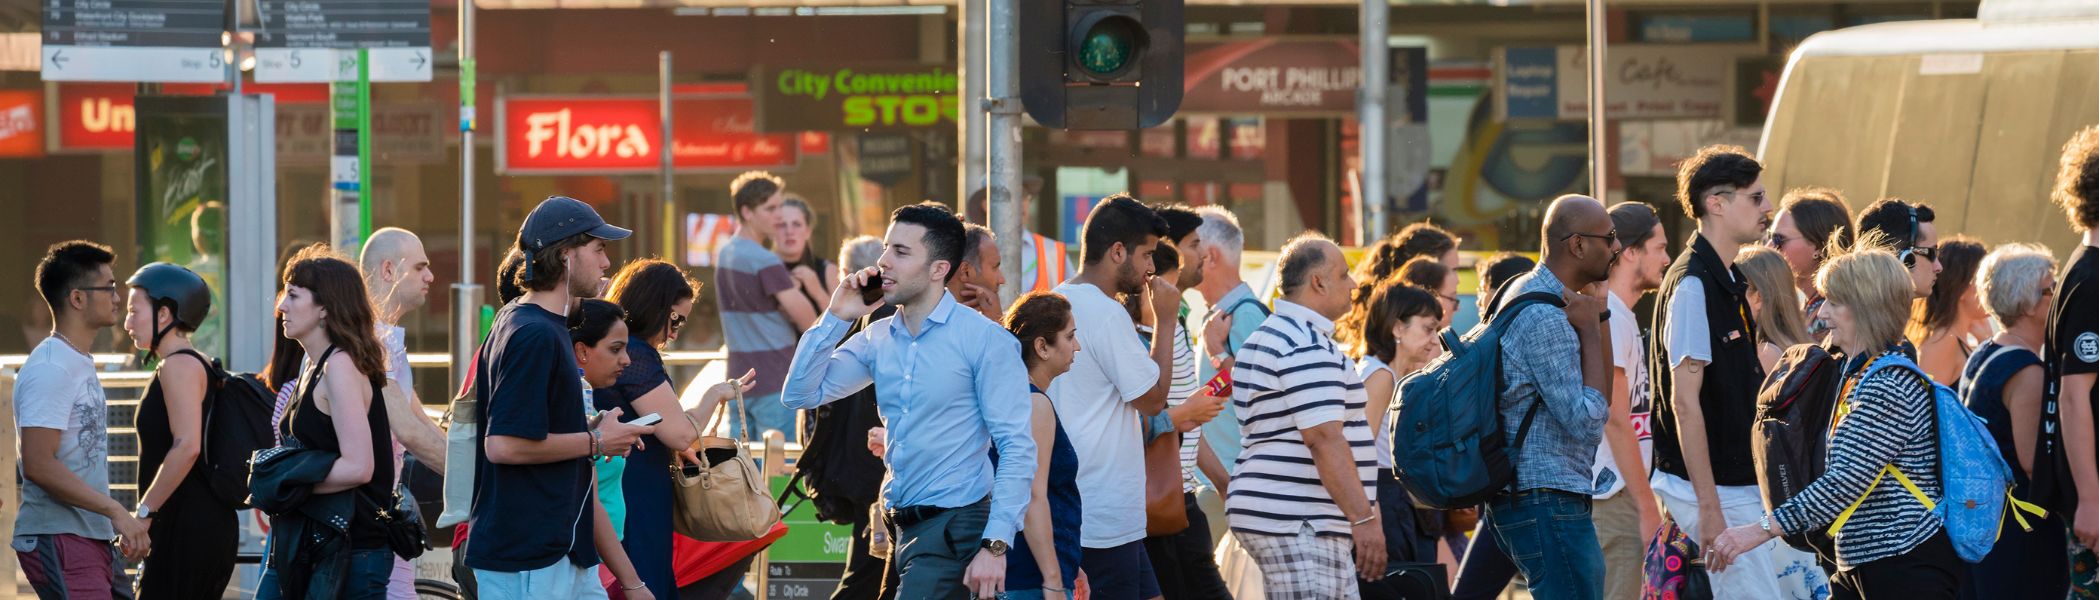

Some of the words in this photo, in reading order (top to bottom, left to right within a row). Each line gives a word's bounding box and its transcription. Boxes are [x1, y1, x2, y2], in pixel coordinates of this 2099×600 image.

[209, 52, 220, 69] 5
[290, 51, 301, 69] 5
[778, 69, 830, 100] City
[1221, 67, 1279, 91] PORT
[1261, 88, 1322, 105] ARCADE
[81, 97, 135, 133] Un
[525, 107, 650, 159] Flora
[1779, 464, 1791, 498] KSILVER
[784, 585, 795, 598] City
[795, 585, 809, 597] Circle
